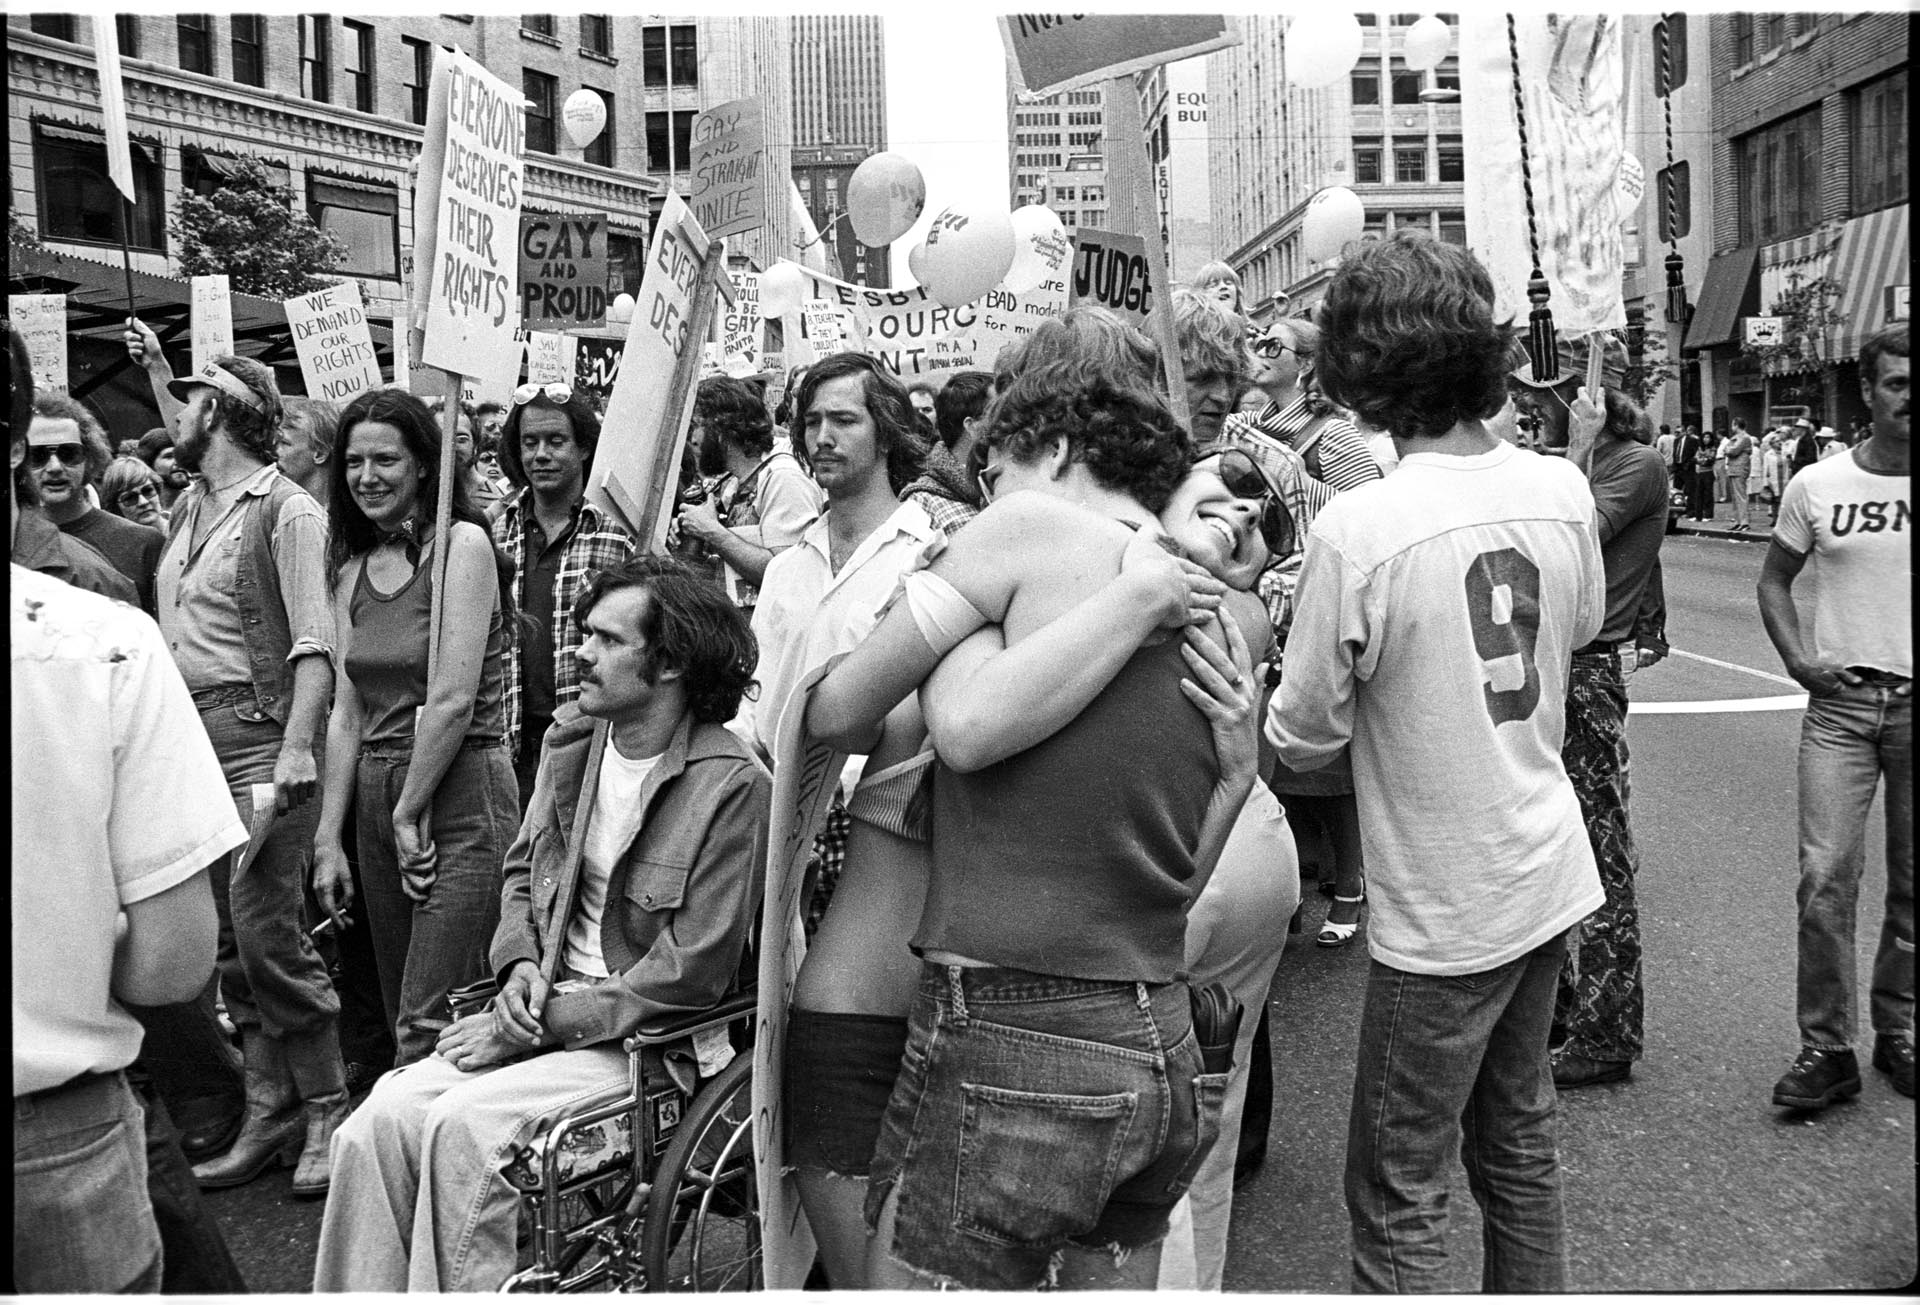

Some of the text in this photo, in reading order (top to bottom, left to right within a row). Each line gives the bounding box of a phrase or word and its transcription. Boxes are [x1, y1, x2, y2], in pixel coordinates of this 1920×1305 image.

[450, 64, 525, 161] EVERYONE
[695, 111, 740, 142] GAY
[698, 141, 740, 164] AND
[447, 138, 518, 210] DESERVES
[694, 150, 764, 196] STRAIGHT
[696, 186, 756, 228] UNITE
[447, 197, 497, 268] THEIR
[523, 221, 599, 260] GAY
[540, 262, 578, 279] AND
[656, 228, 700, 305] EVER
[305, 291, 337, 313] WE
[442, 252, 509, 328] RIGHTS
[523, 282, 607, 322] PROUD
[986, 289, 1018, 312] BAD
[294, 306, 362, 341] DEMAND
[724, 314, 761, 333] GAY
[742, 302, 759, 315] BE
[984, 314, 1008, 332] for
[321, 332, 351, 350] OUR
[649, 291, 689, 361] DES
[312, 341, 373, 374] RIGHTS
[724, 335, 755, 356] ANITA
[952, 339, 962, 353] A
[1464, 547, 1542, 730] 9
